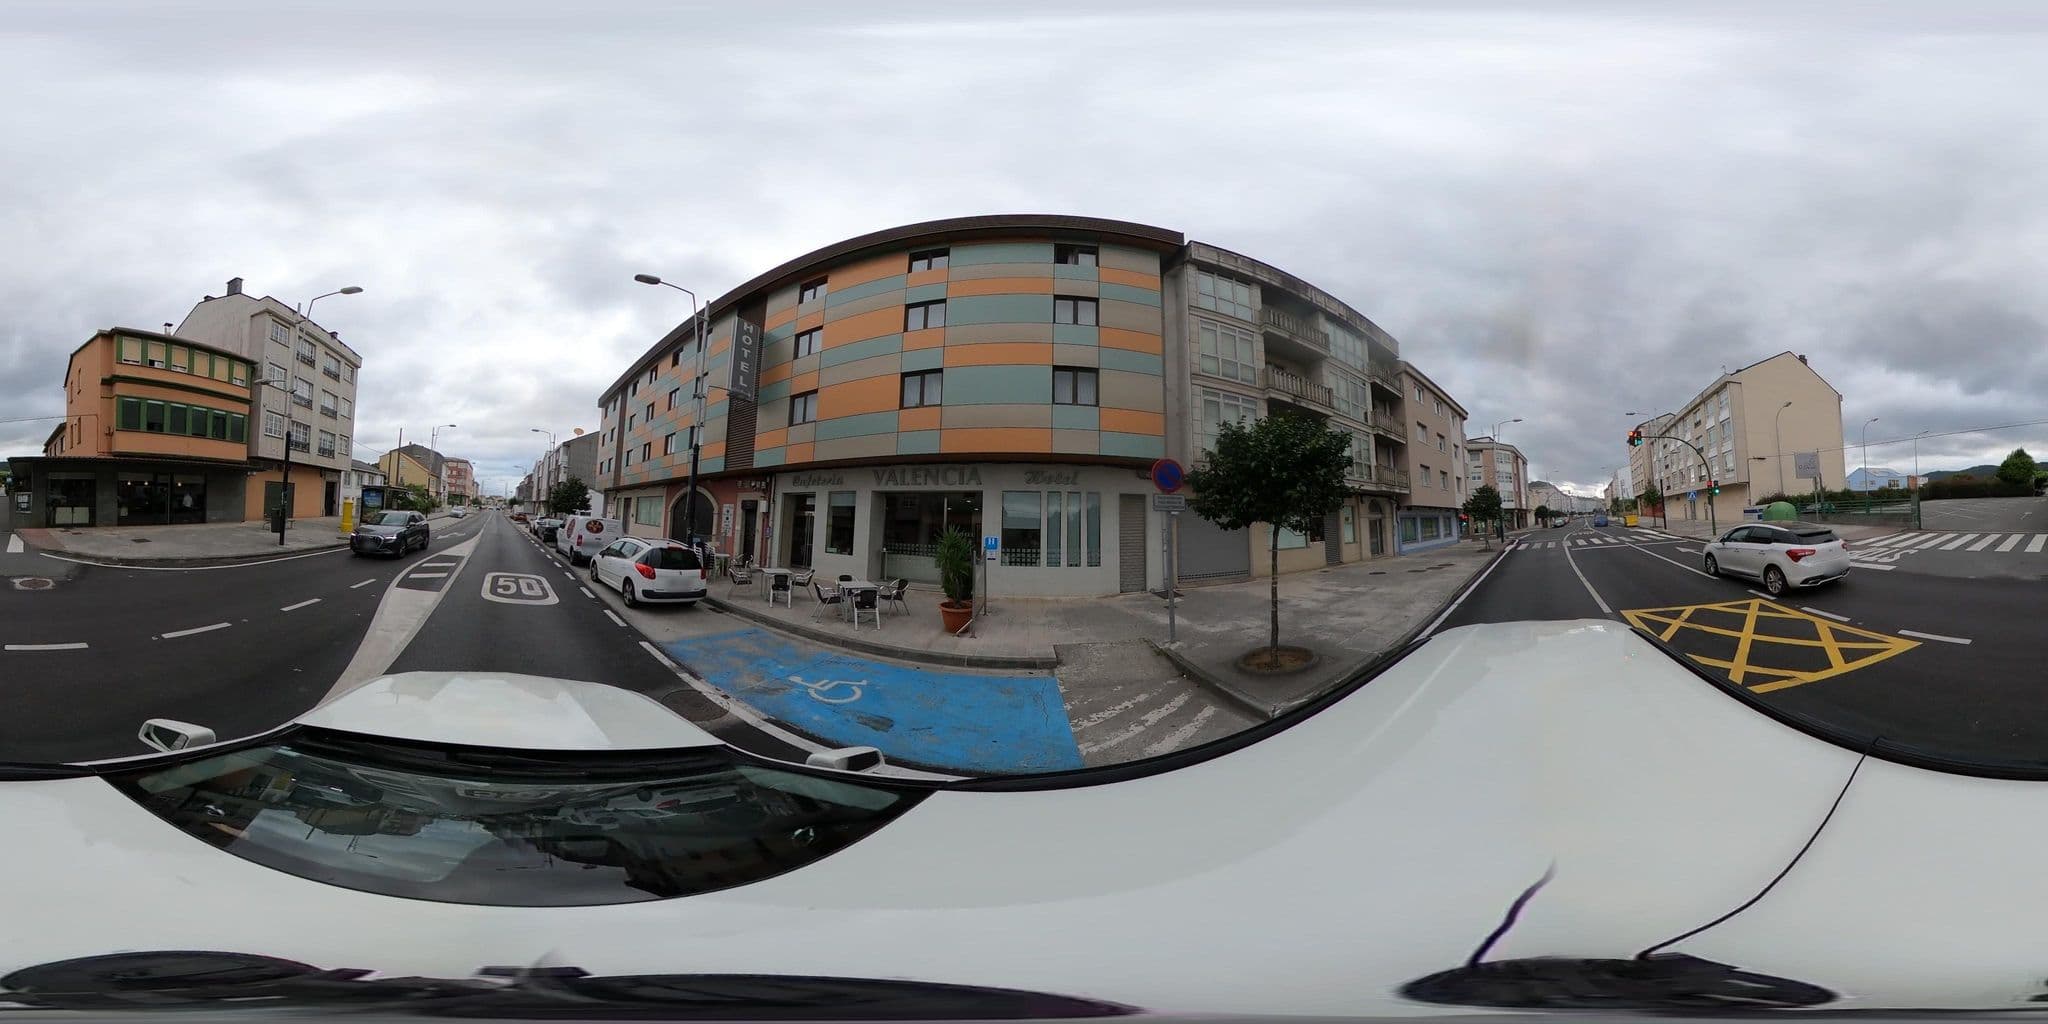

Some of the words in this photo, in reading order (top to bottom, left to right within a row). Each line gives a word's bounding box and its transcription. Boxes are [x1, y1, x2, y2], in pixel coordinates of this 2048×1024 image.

[739, 322, 753, 388] HOTEL
[872, 466, 982, 486] VALENCIA
[497, 577, 543, 596] 50
